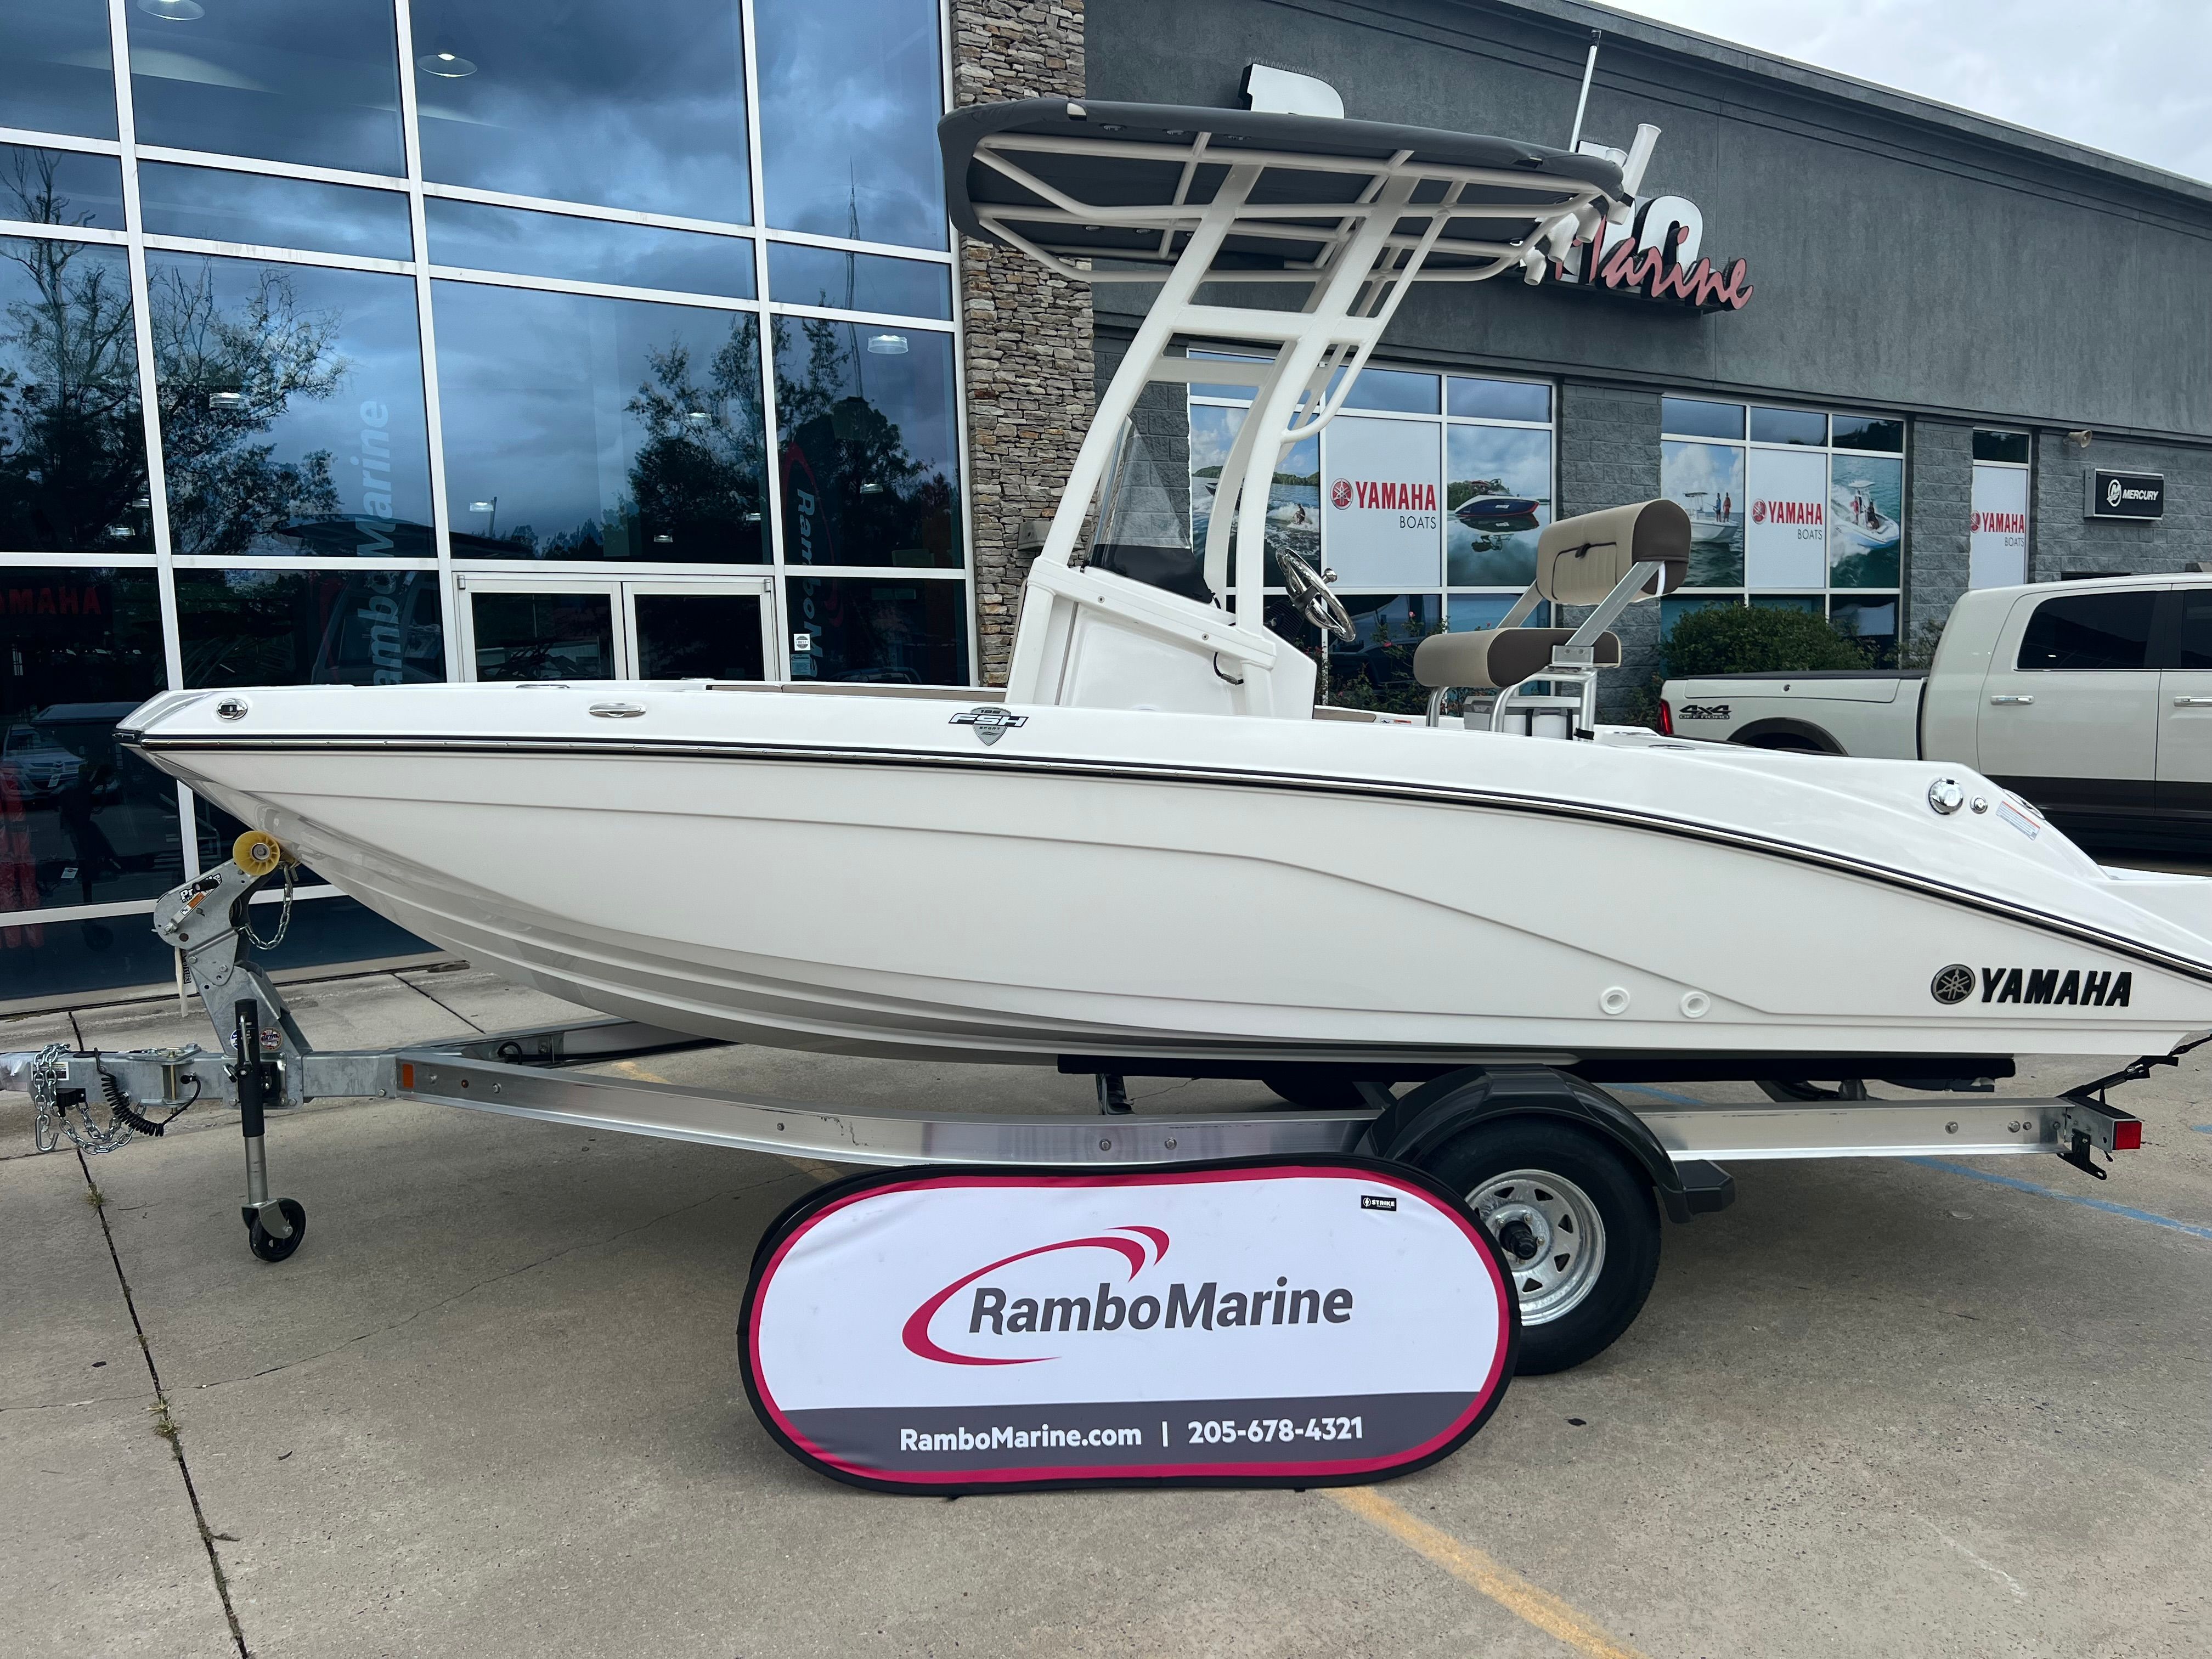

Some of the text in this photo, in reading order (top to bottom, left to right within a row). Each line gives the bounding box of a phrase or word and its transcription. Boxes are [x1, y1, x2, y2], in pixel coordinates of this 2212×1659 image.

[1355, 481, 1436, 511] YAMAHA
[2122, 489, 2159, 501] MERCURY
[1400, 516, 1436, 529] BOATS
[1768, 500, 1823, 525] YAMAHA
[1982, 512, 2025, 533] YAMAHA
[350, 401, 403, 685] amboMarine
[1797, 529, 1822, 540] BOATS
[2004, 537, 2024, 547] BOATS
[0, 586, 103, 615] MAHA
[949, 713, 1028, 727] FSH
[1982, 967, 2132, 1007] YAMAHA
[969, 1276, 1353, 1335] RamboMarine
[900, 1416, 1363, 1451] RamboMarine.com 205-678-4321
